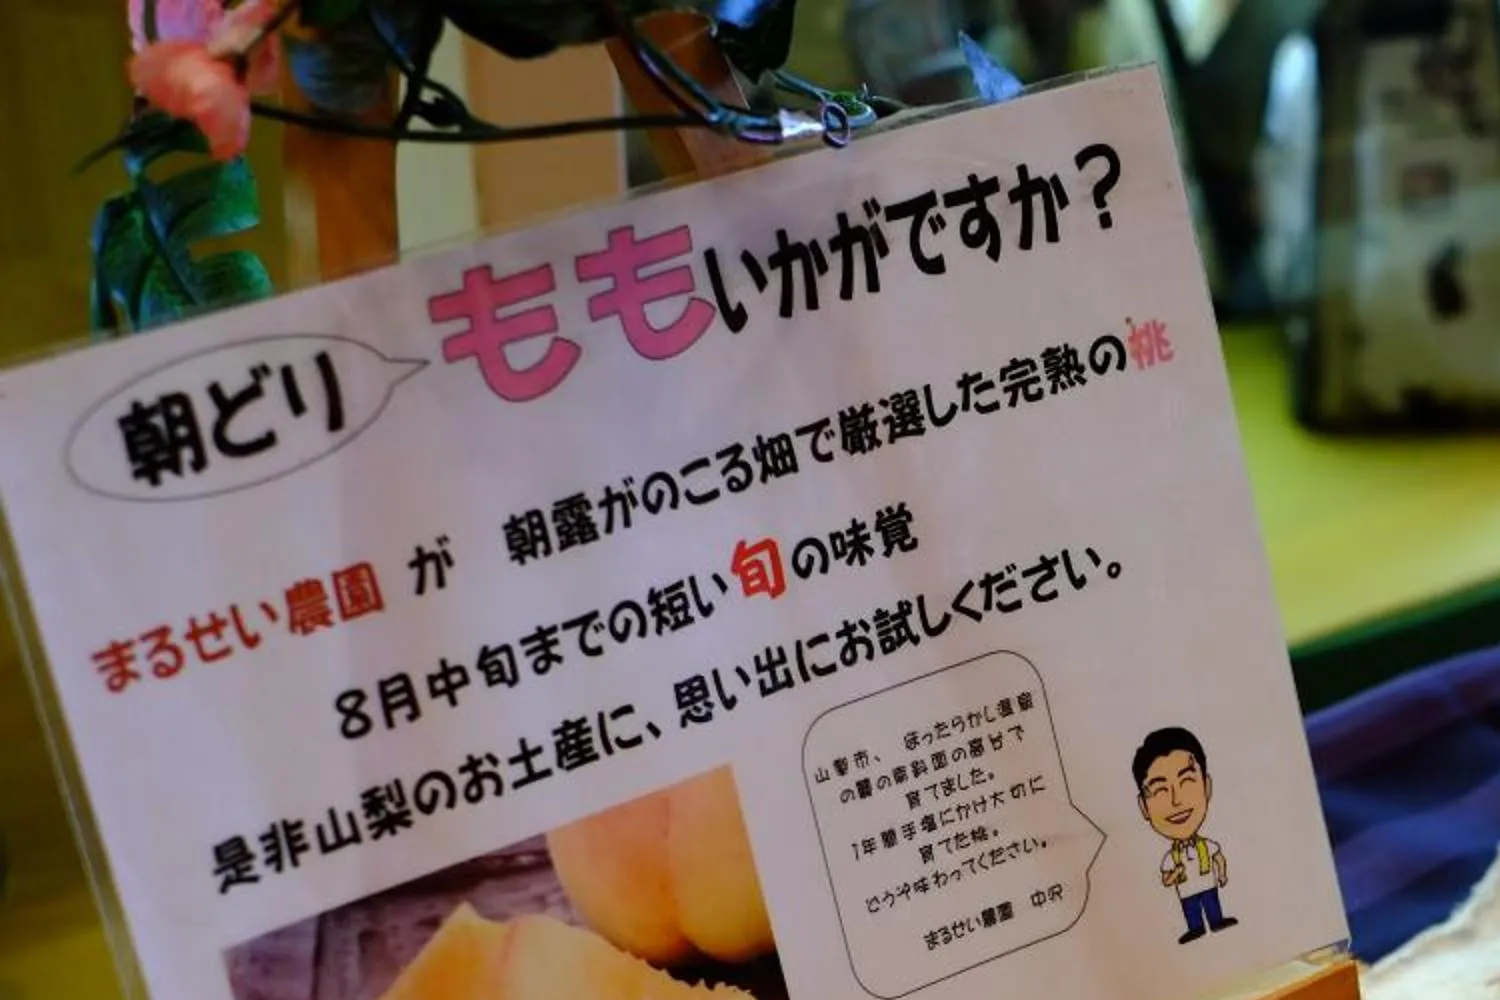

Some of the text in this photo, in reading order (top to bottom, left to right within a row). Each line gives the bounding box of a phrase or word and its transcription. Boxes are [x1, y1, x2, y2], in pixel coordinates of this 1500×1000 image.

[116, 352, 346, 487] 朝どり
[92, 561, 386, 693] まるせい農園
[409, 534, 455, 597] が
[905, 767, 995, 811] 育てました。
[865, 837, 1047, 914] どうぞ味わってください。
[924, 901, 1014, 951] まるせい農園
